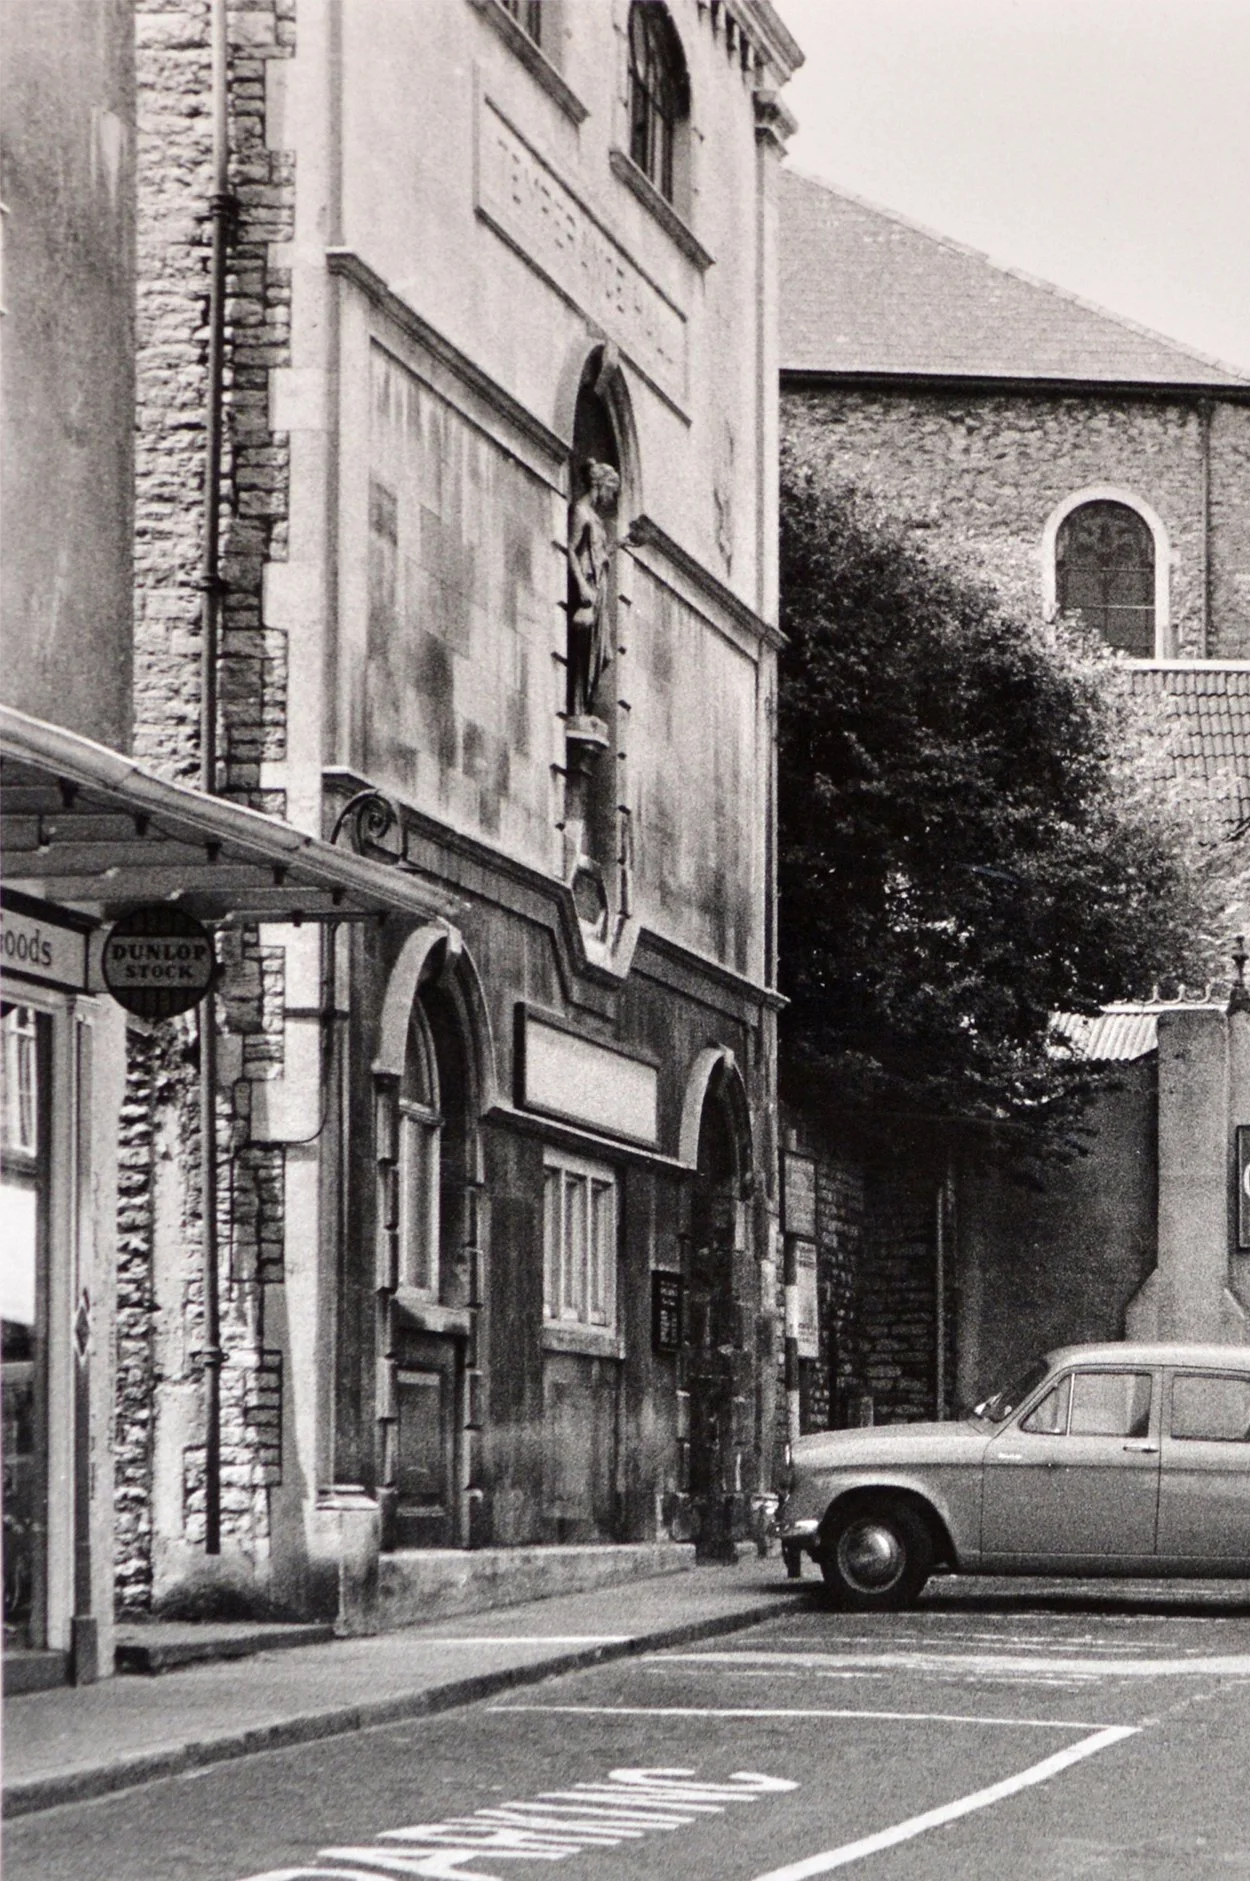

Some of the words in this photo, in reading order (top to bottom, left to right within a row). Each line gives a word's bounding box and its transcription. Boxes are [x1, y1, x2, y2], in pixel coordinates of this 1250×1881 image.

[0, 929, 52, 967] oods
[112, 943, 207, 960] DUNLOP
[125, 965, 194, 979] STOCK
[235, 1767, 802, 1881] ARKING
